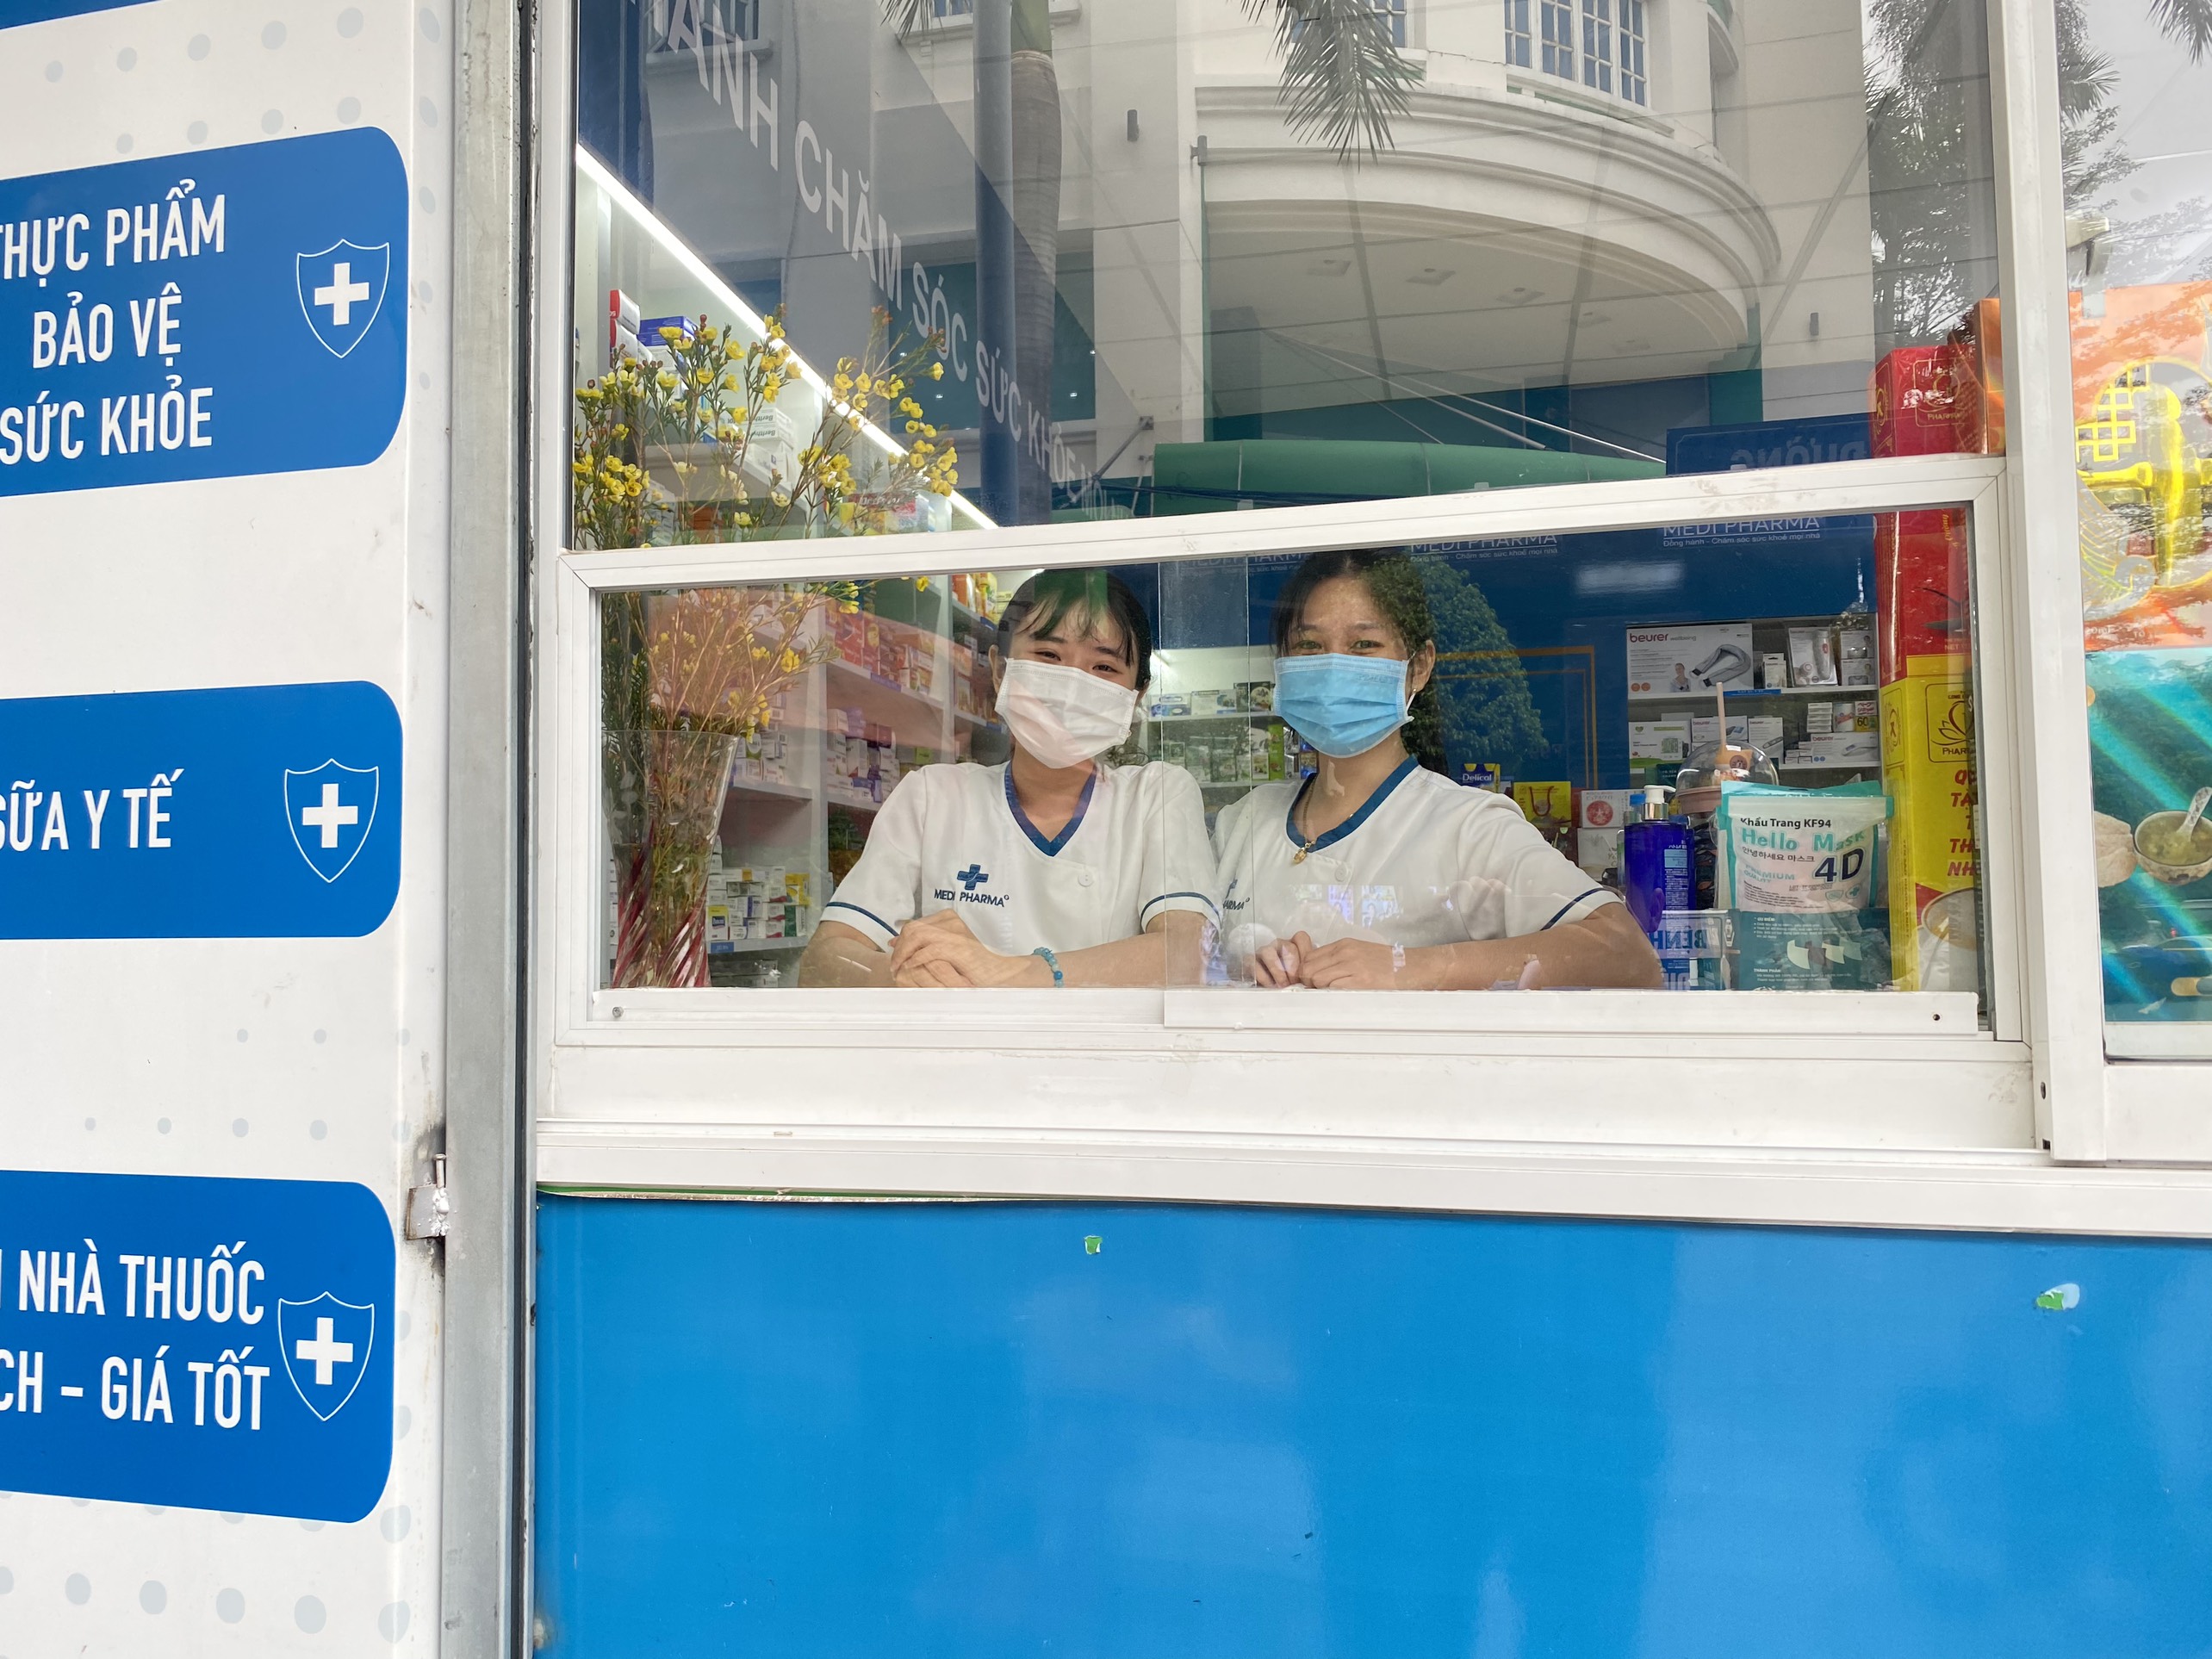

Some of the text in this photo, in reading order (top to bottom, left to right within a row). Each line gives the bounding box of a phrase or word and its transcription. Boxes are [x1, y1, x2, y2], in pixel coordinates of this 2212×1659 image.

[0, 178, 226, 287] HỰC PHẨM
[795, 120, 902, 311] CHĂM
[913, 262, 968, 382] SÓC
[976, 340, 1022, 442] SỨC
[32, 282, 183, 369] BẢO VỆ
[0, 374, 214, 465] SỨC KHỎE
[1630, 633, 1669, 643] beurer
[84, 789, 110, 850] Y
[122, 768, 184, 848] TẾ
[1741, 827, 1799, 851] Hello
[1770, 818, 1801, 830] Trang
[1804, 818, 1831, 828] KF94
[934, 888, 956, 901] MEDI
[1742, 846, 1785, 861] 안녕하세요
[1814, 848, 1865, 882] 4D
[19, 1238, 265, 1325] NHÀ THUỐC
[101, 1345, 174, 1424] GIÁ
[188, 1345, 270, 1431] TỐT
